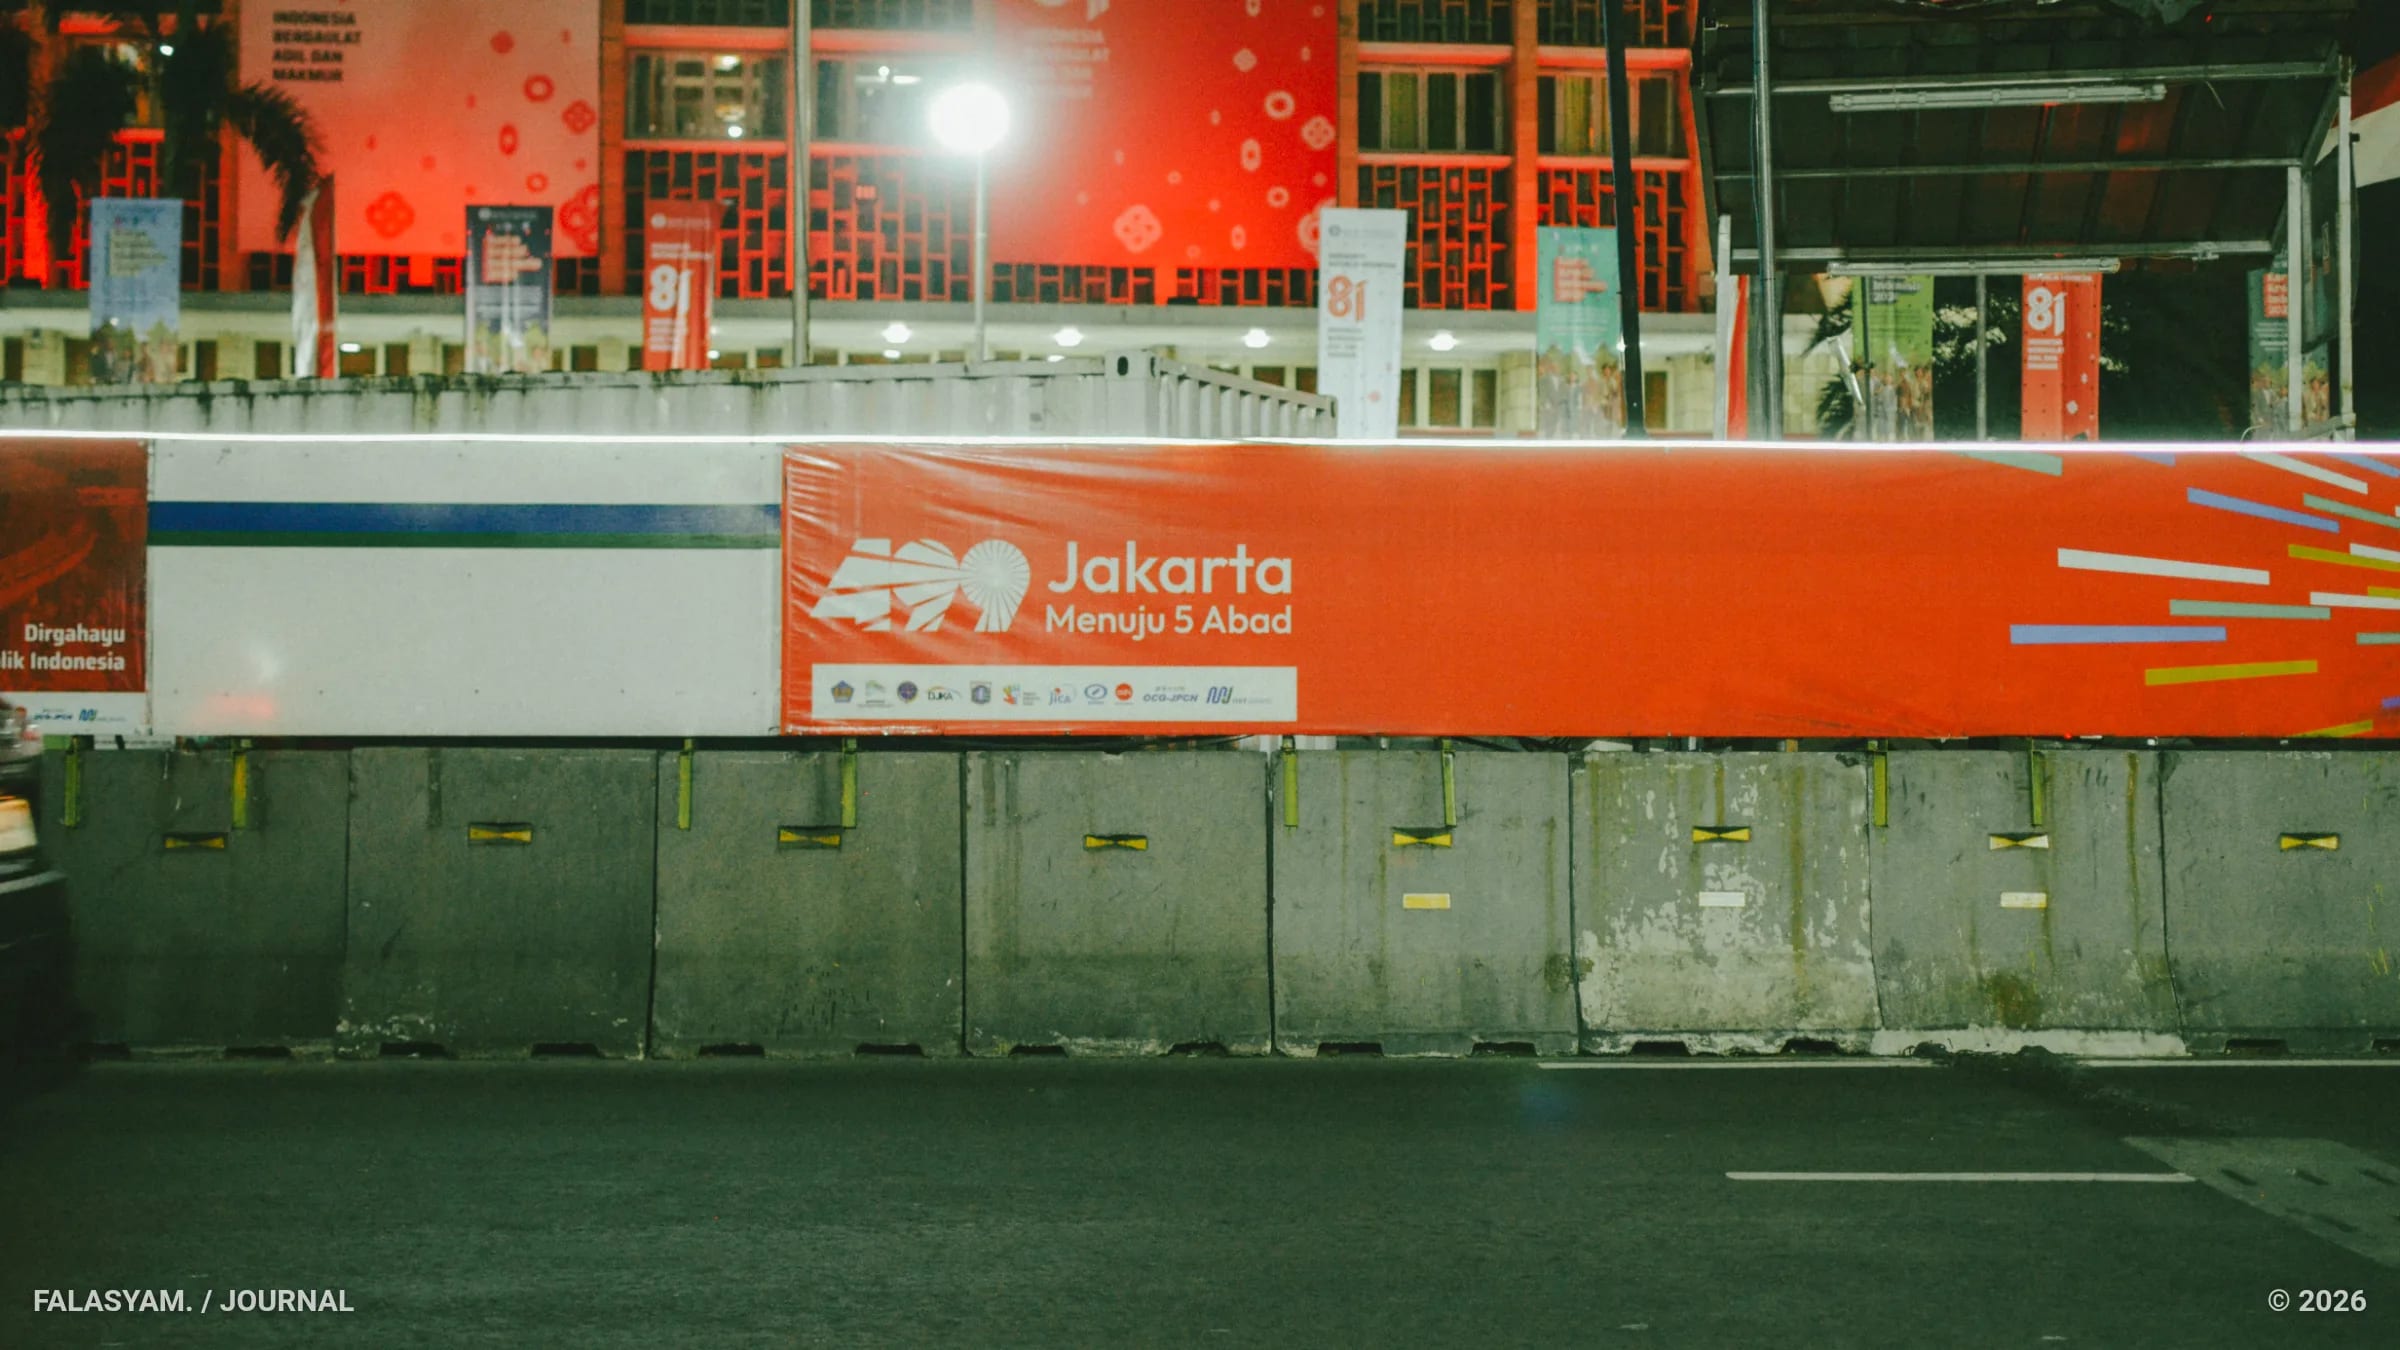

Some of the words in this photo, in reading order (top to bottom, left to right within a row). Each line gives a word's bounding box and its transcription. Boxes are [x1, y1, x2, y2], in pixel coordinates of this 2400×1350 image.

[650, 264, 693, 316] 81
[1327, 274, 1368, 323] 81
[2027, 286, 2067, 336] 81
[1048, 540, 1292, 594] Jakarta
[25, 622, 126, 647] Dirgahayu
[1046, 604, 1165, 641] Menuju
[1173, 605, 1194, 633] 5
[1201, 604, 1292, 634] Abad
[0, 650, 25, 670] lik
[30, 651, 126, 671] Indonesia
